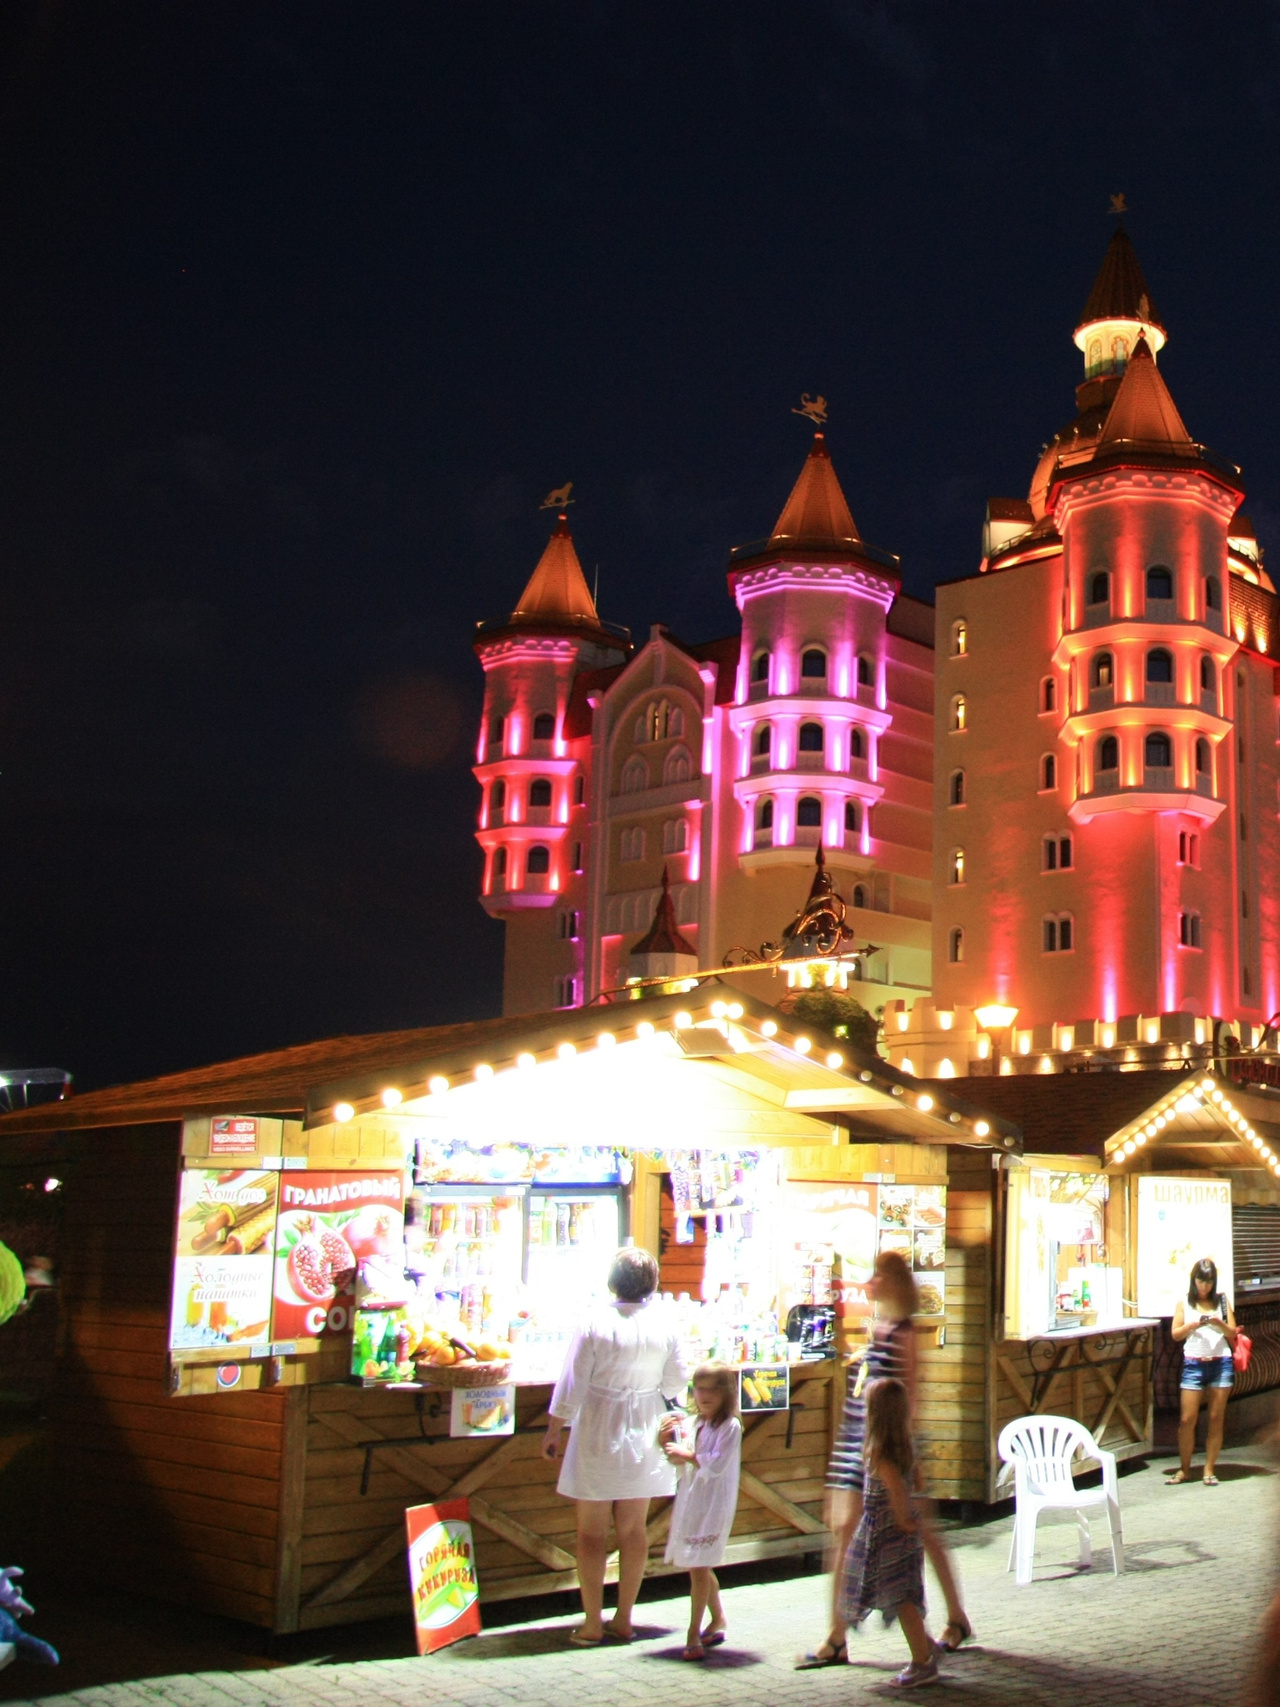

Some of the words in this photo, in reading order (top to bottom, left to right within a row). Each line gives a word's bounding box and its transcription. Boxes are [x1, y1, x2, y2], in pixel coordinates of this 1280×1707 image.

[284, 1176, 401, 1206] ГРАНАТОВЫЙ
[418, 1542, 471, 1572] ГОРЯЧАЯ
[417, 1566, 476, 1601] КУКУРУЗА
